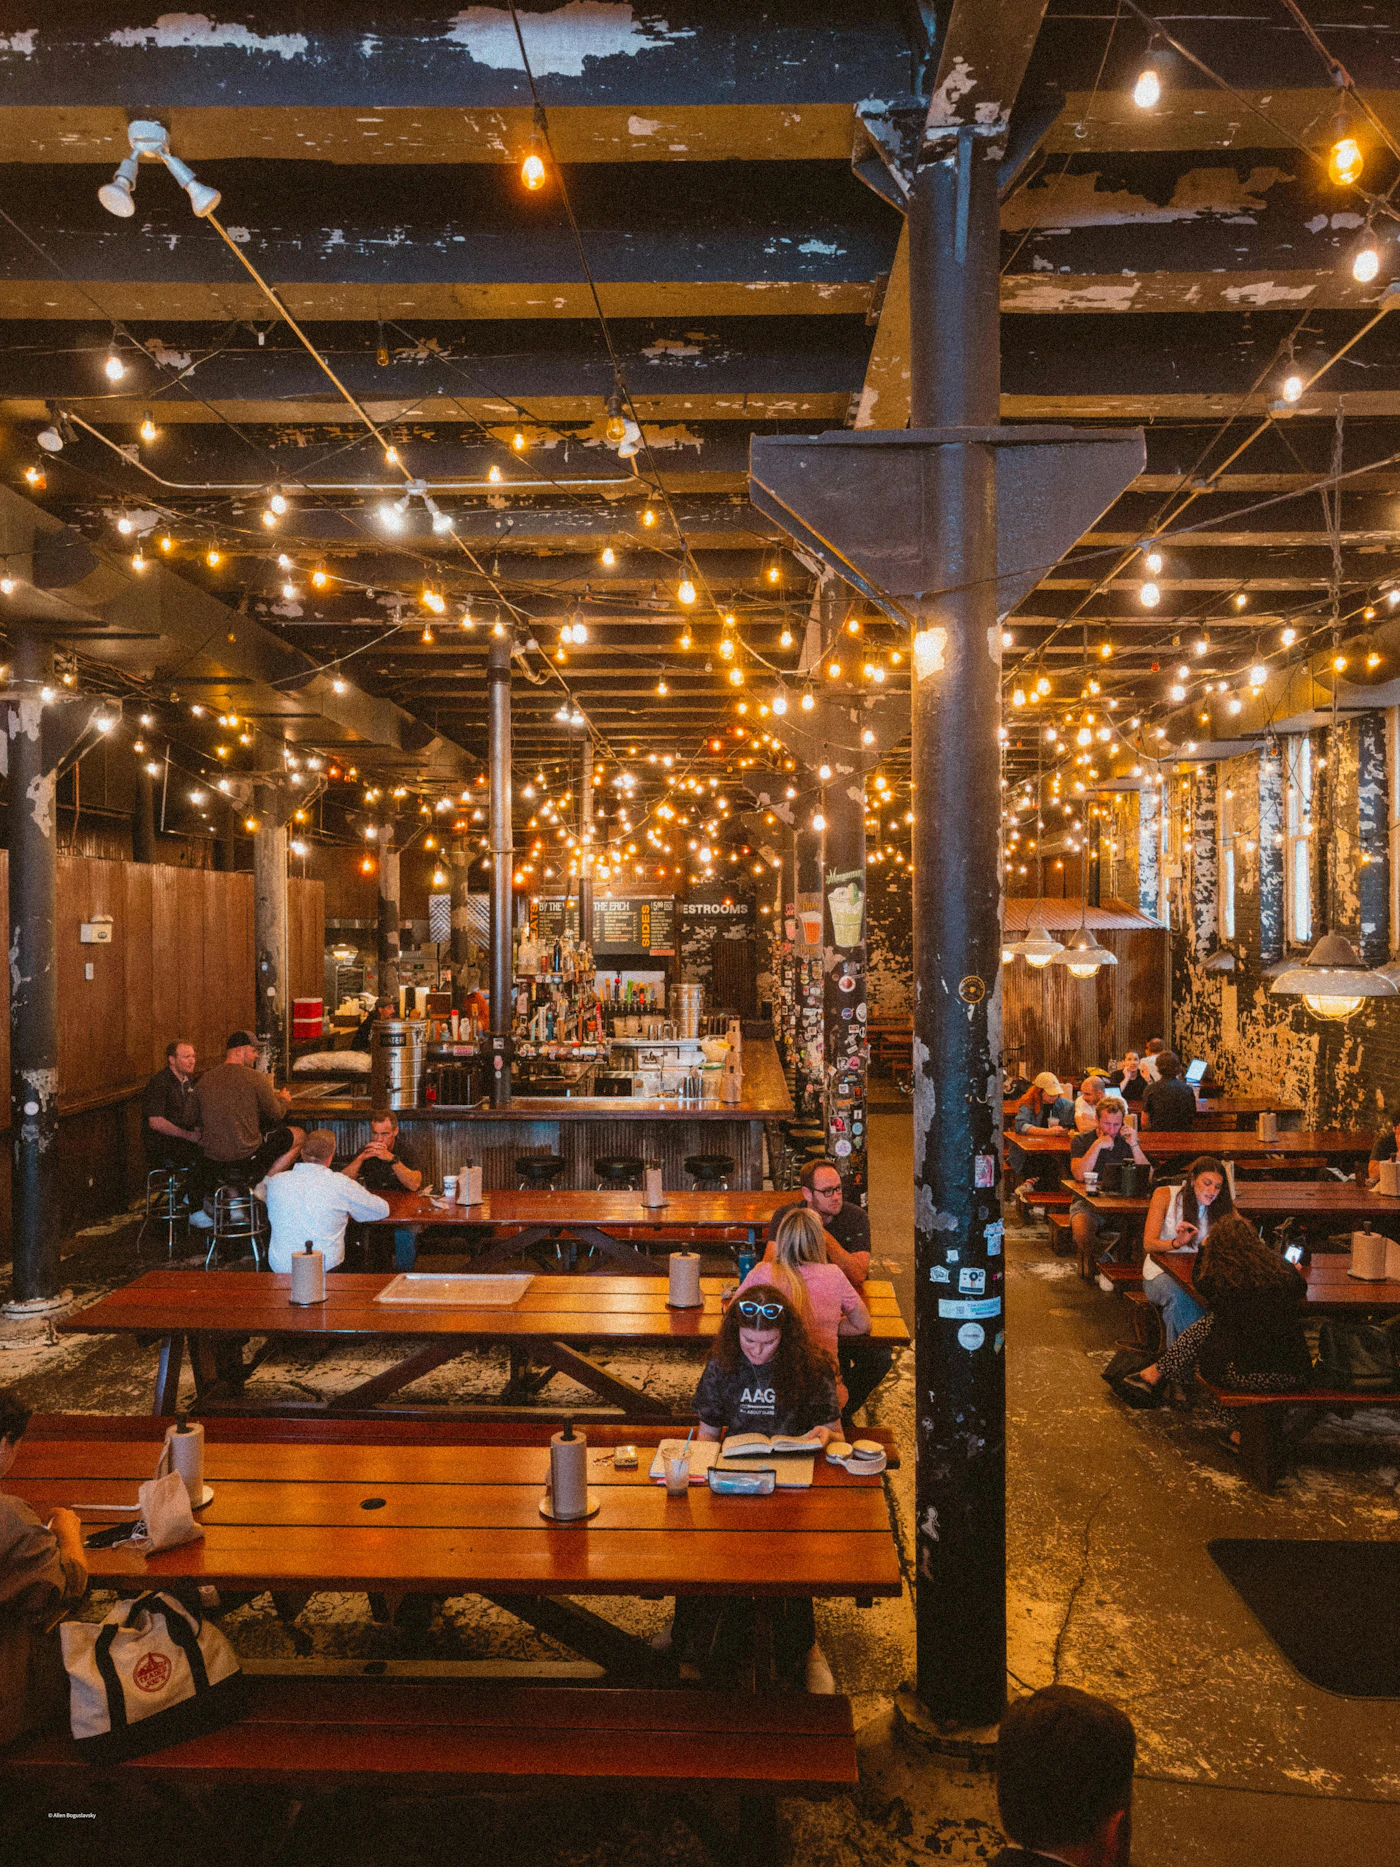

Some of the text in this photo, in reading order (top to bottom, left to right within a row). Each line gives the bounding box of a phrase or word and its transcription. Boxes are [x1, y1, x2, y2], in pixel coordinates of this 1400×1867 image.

[549, 902, 562, 911] THE
[593, 901, 608, 911] THE
[641, 904, 650, 947] SIDES
[740, 1388, 776, 1403] AAG
